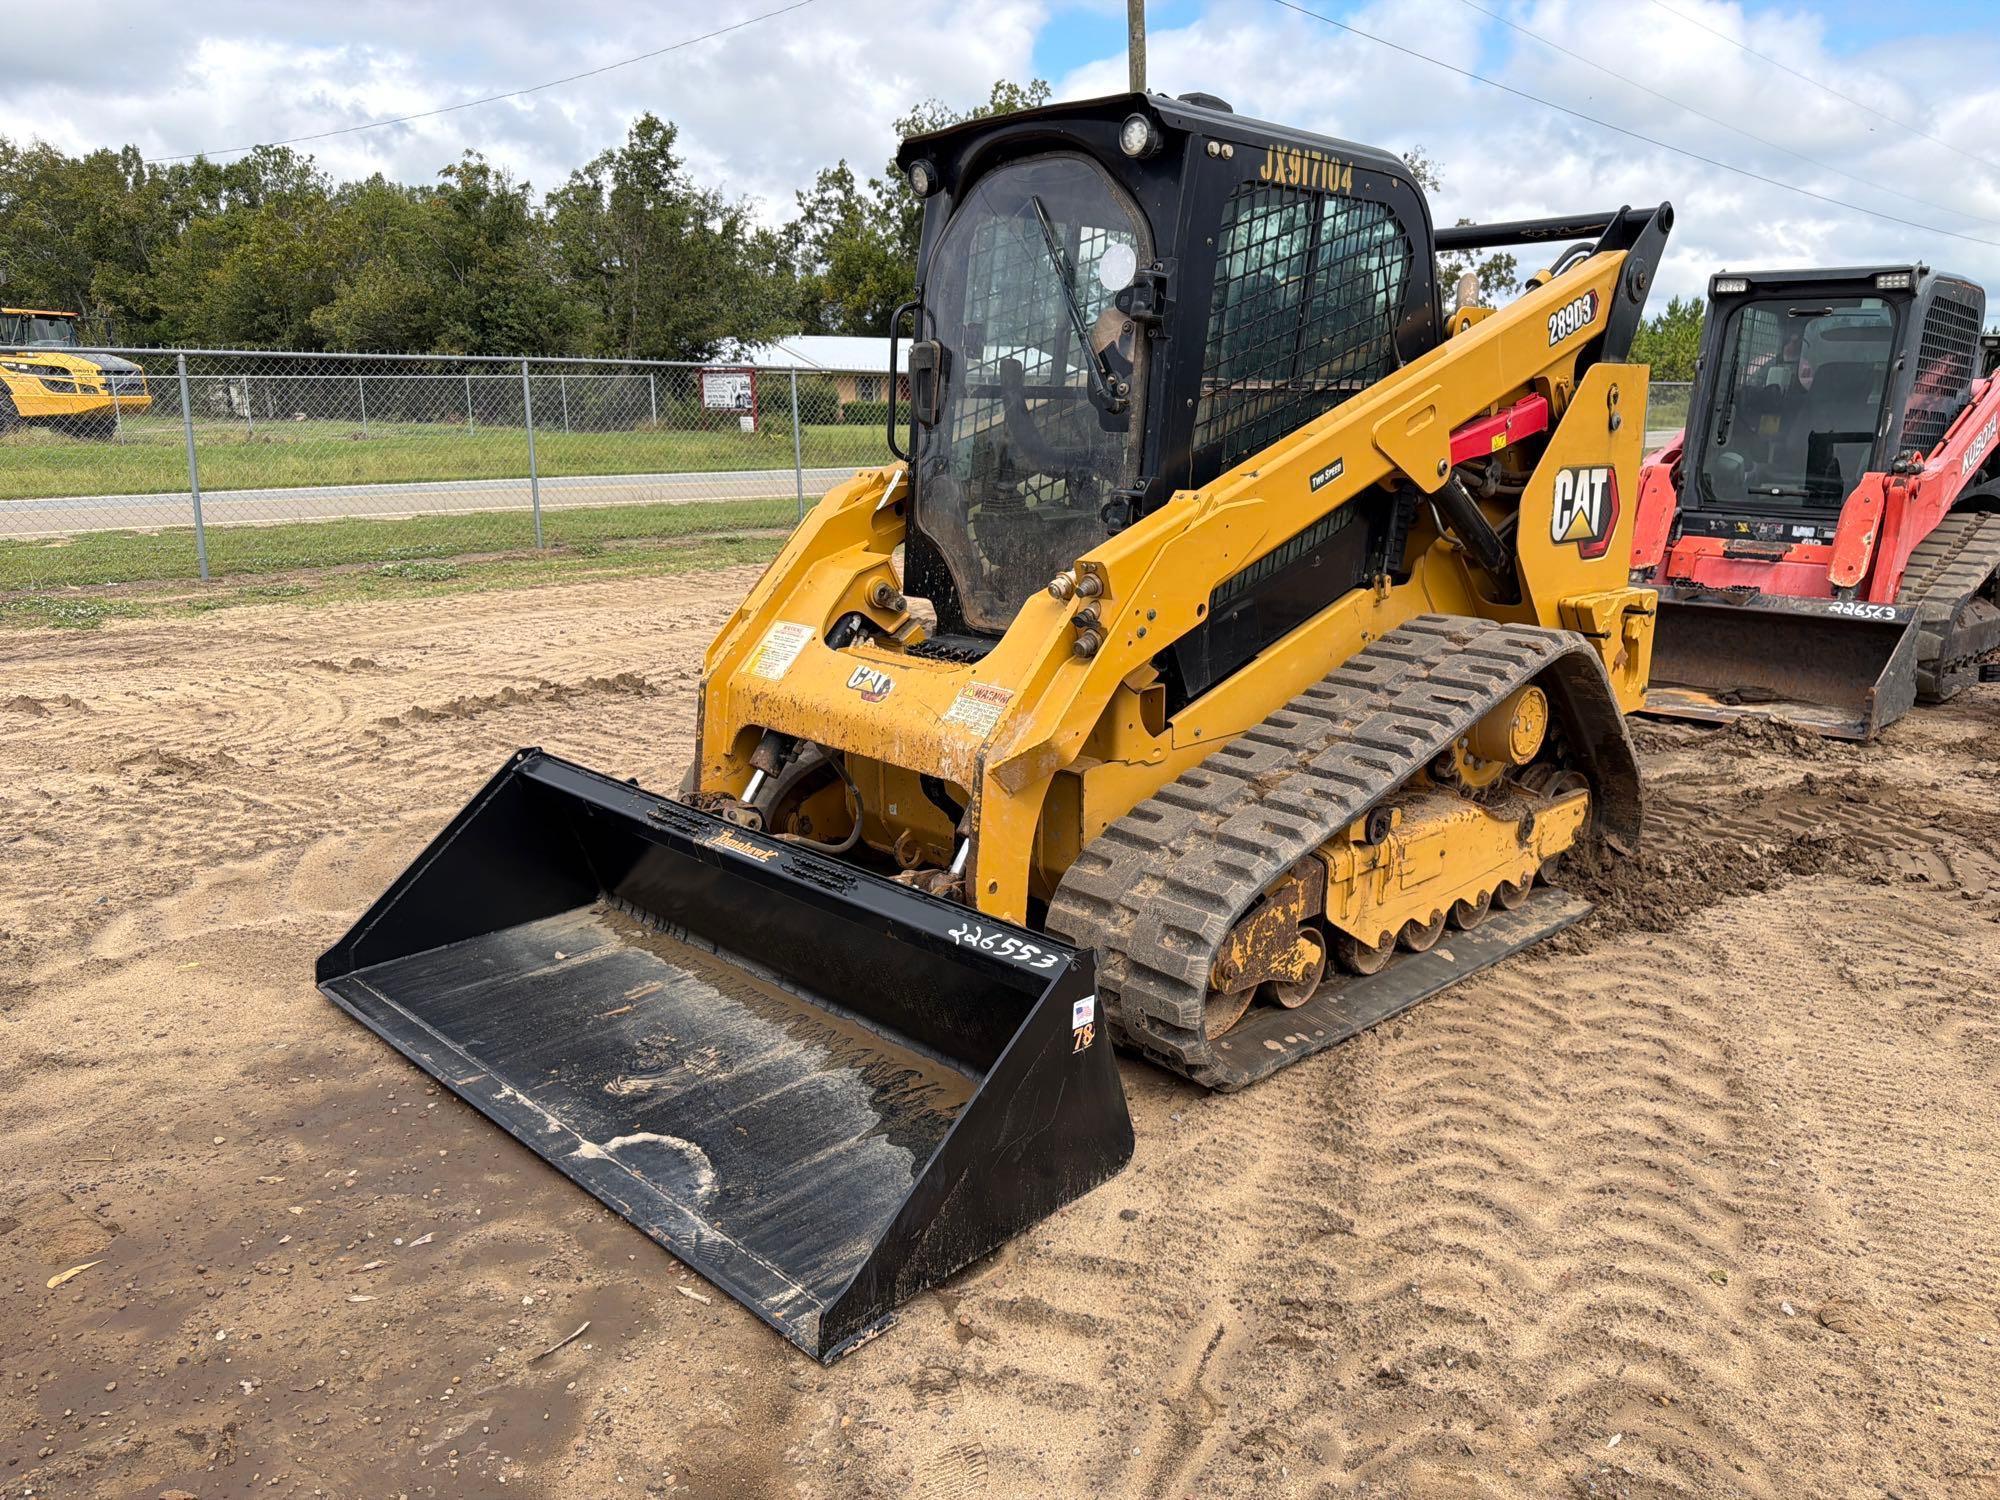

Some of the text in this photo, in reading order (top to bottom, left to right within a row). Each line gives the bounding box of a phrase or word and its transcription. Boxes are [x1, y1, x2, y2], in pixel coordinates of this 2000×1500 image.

[1548, 294, 1592, 347] 289D3
[1551, 467, 1608, 542] CAT
[948, 923, 1059, 968] 226553
